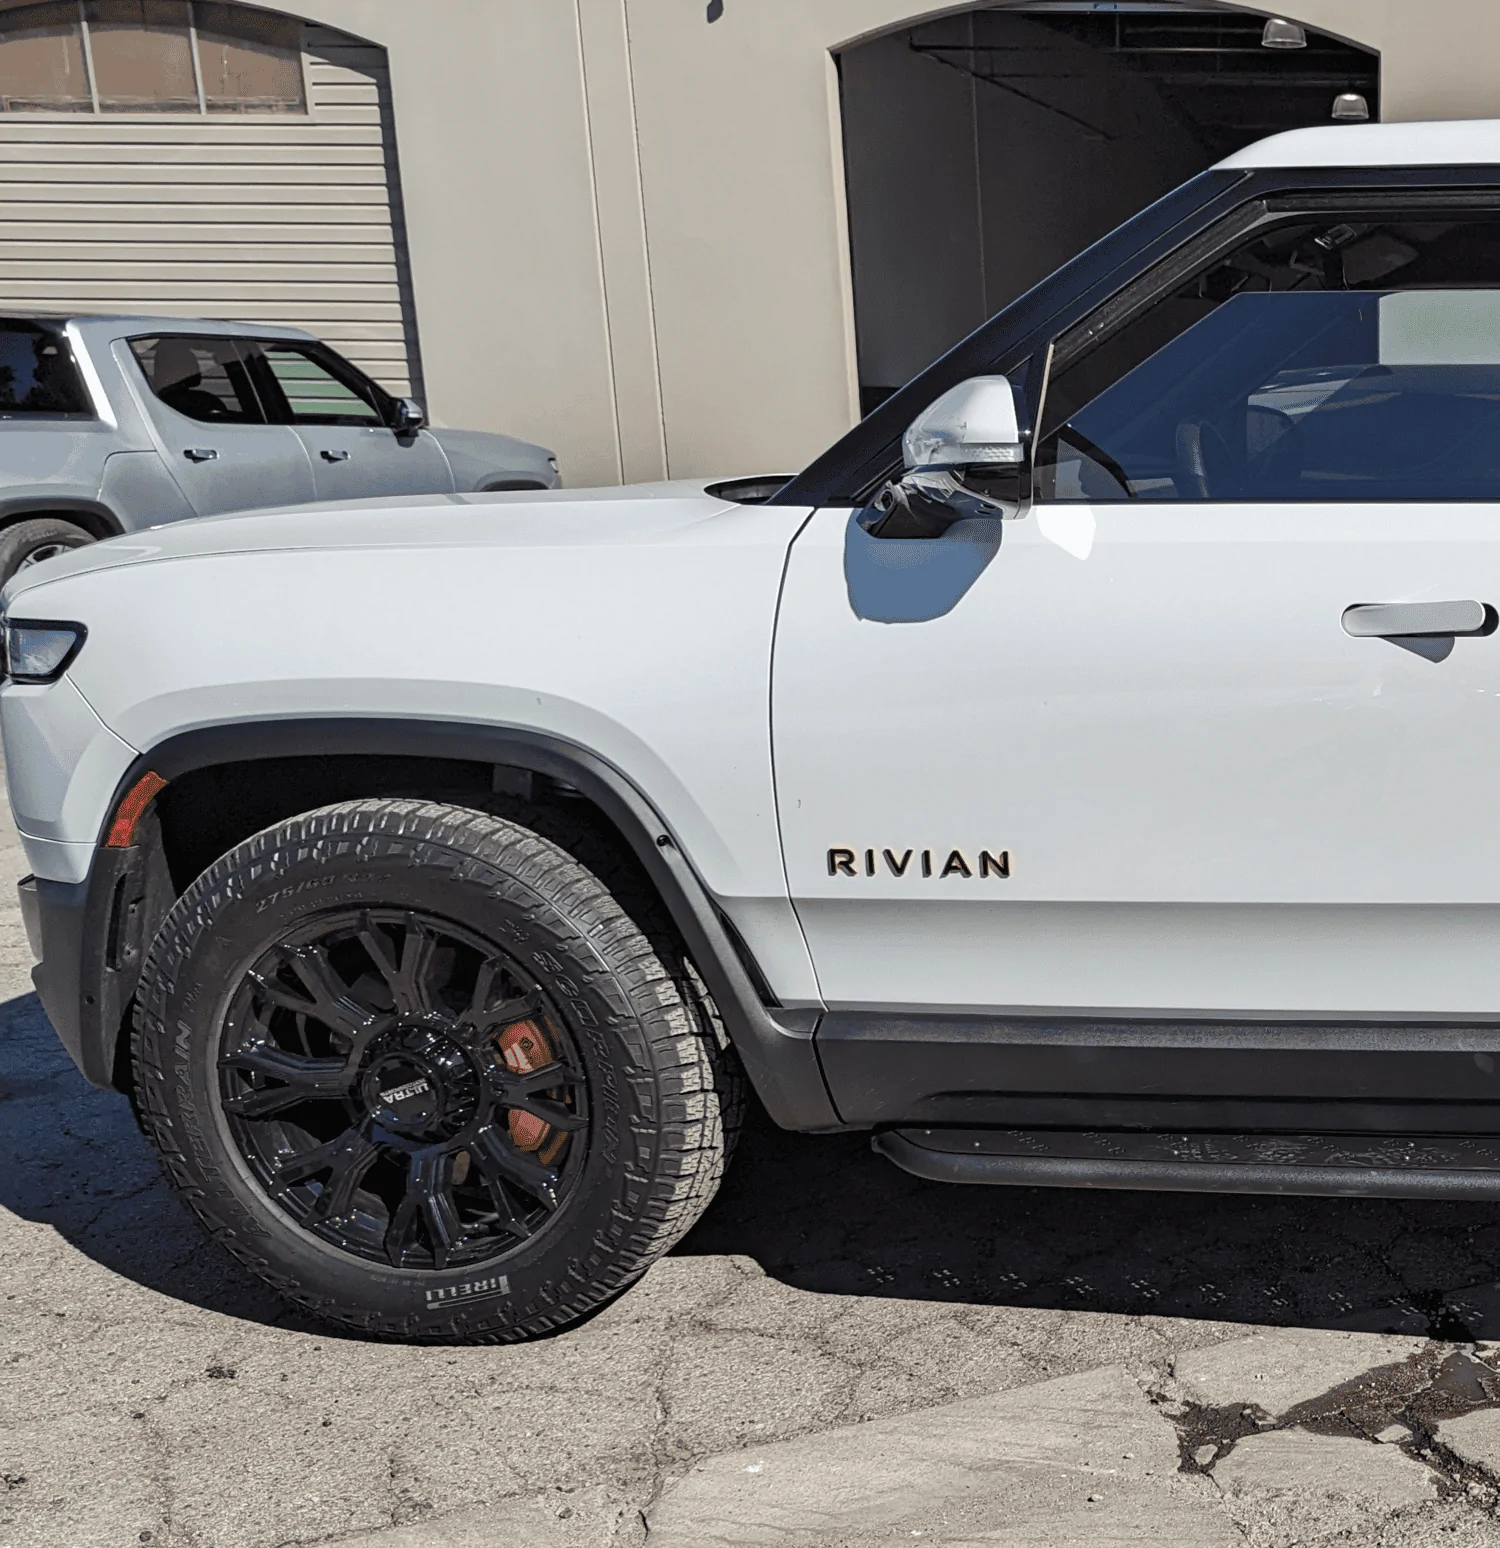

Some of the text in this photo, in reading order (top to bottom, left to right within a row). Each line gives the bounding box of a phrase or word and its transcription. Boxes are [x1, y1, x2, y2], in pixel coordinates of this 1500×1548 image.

[827, 848, 1011, 879] RIVIAN
[383, 1083, 429, 1104] ULTRA
[425, 1275, 511, 1309] PIRELLI
